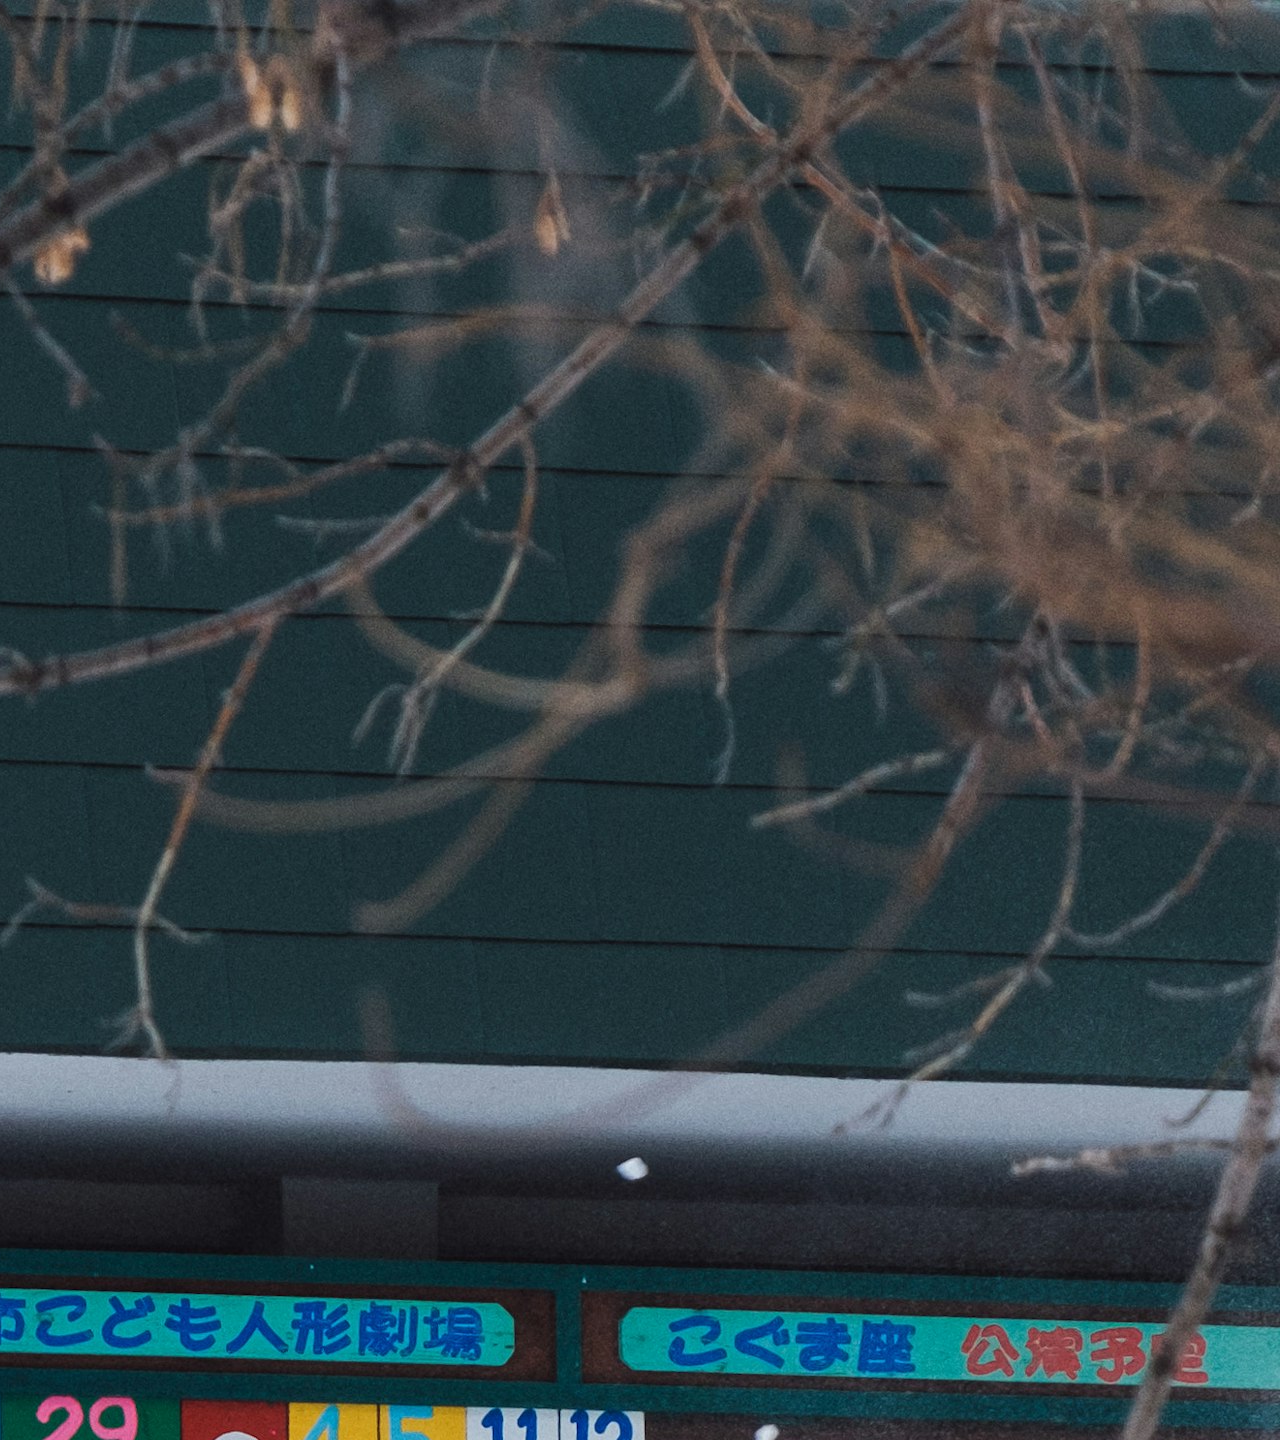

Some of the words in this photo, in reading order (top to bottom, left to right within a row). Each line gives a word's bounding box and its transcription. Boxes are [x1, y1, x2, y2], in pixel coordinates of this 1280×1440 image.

[667, 1315, 916, 1374] こぐま座
[960, 1323, 1209, 1384] 公演予定
